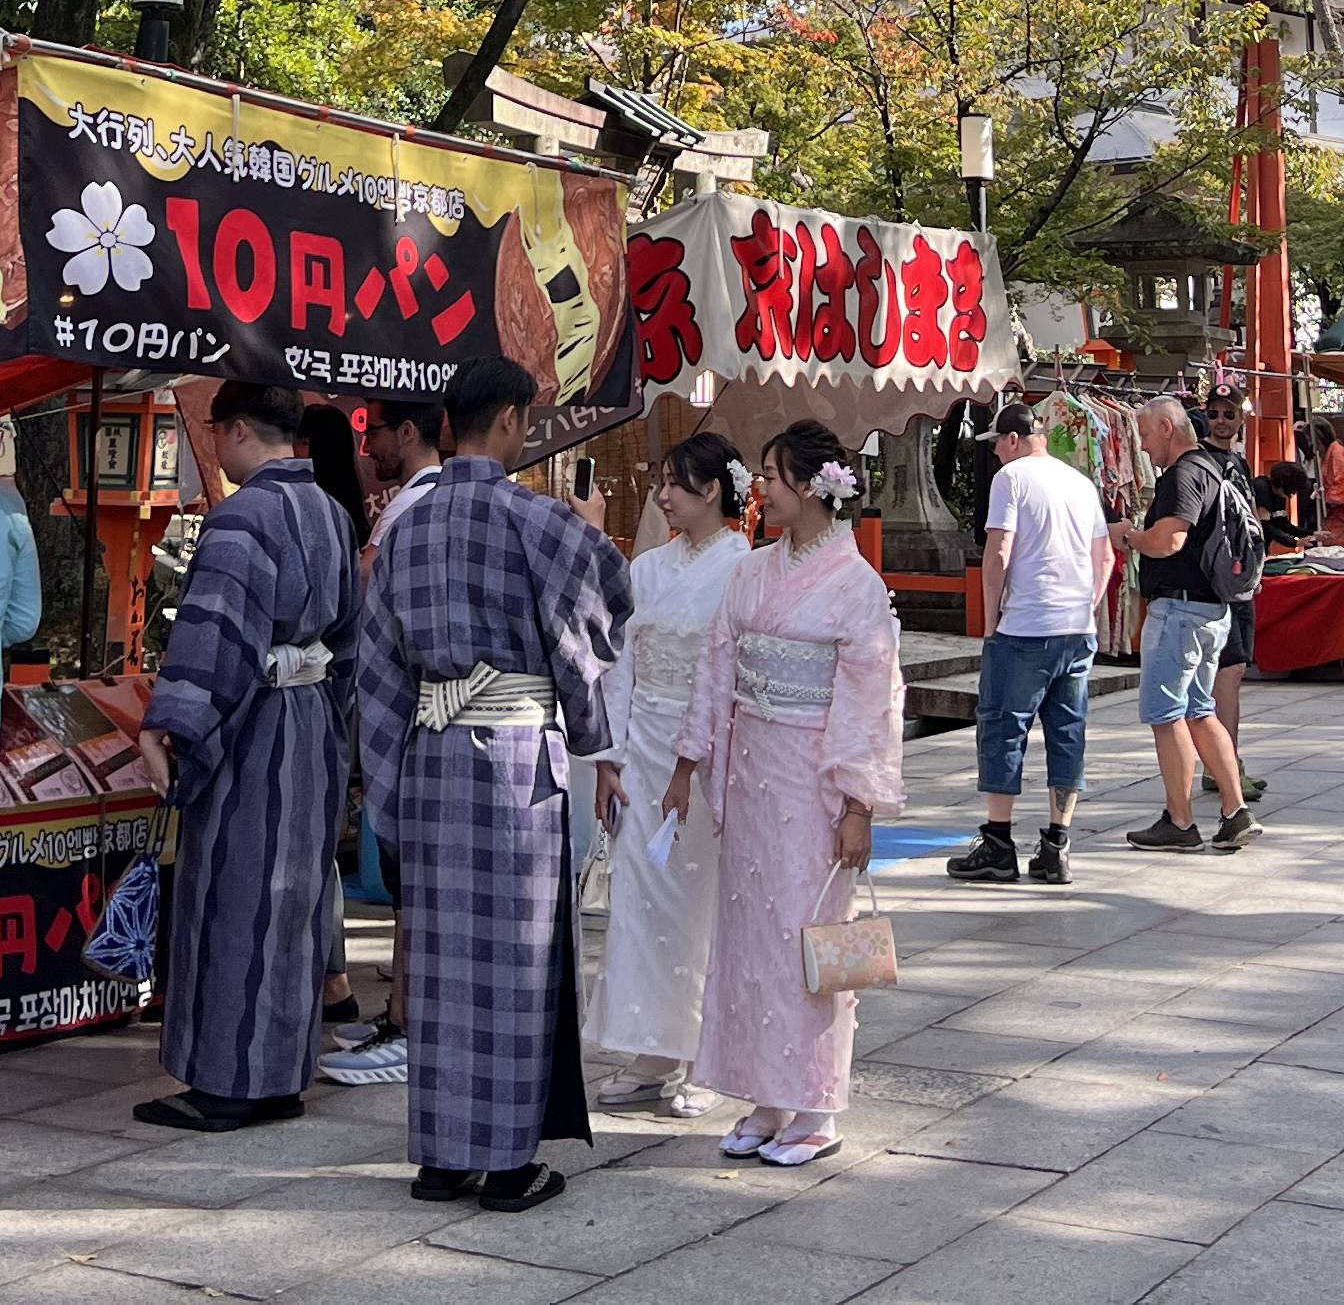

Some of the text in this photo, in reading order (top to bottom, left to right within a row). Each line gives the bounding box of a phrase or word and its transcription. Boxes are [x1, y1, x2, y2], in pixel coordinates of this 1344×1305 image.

[166, 196, 477, 346] 10円パン
[731, 208, 987, 372] 京はしまき
[53, 314, 231, 364] #10円パン
[285, 345, 332, 383] 한국
